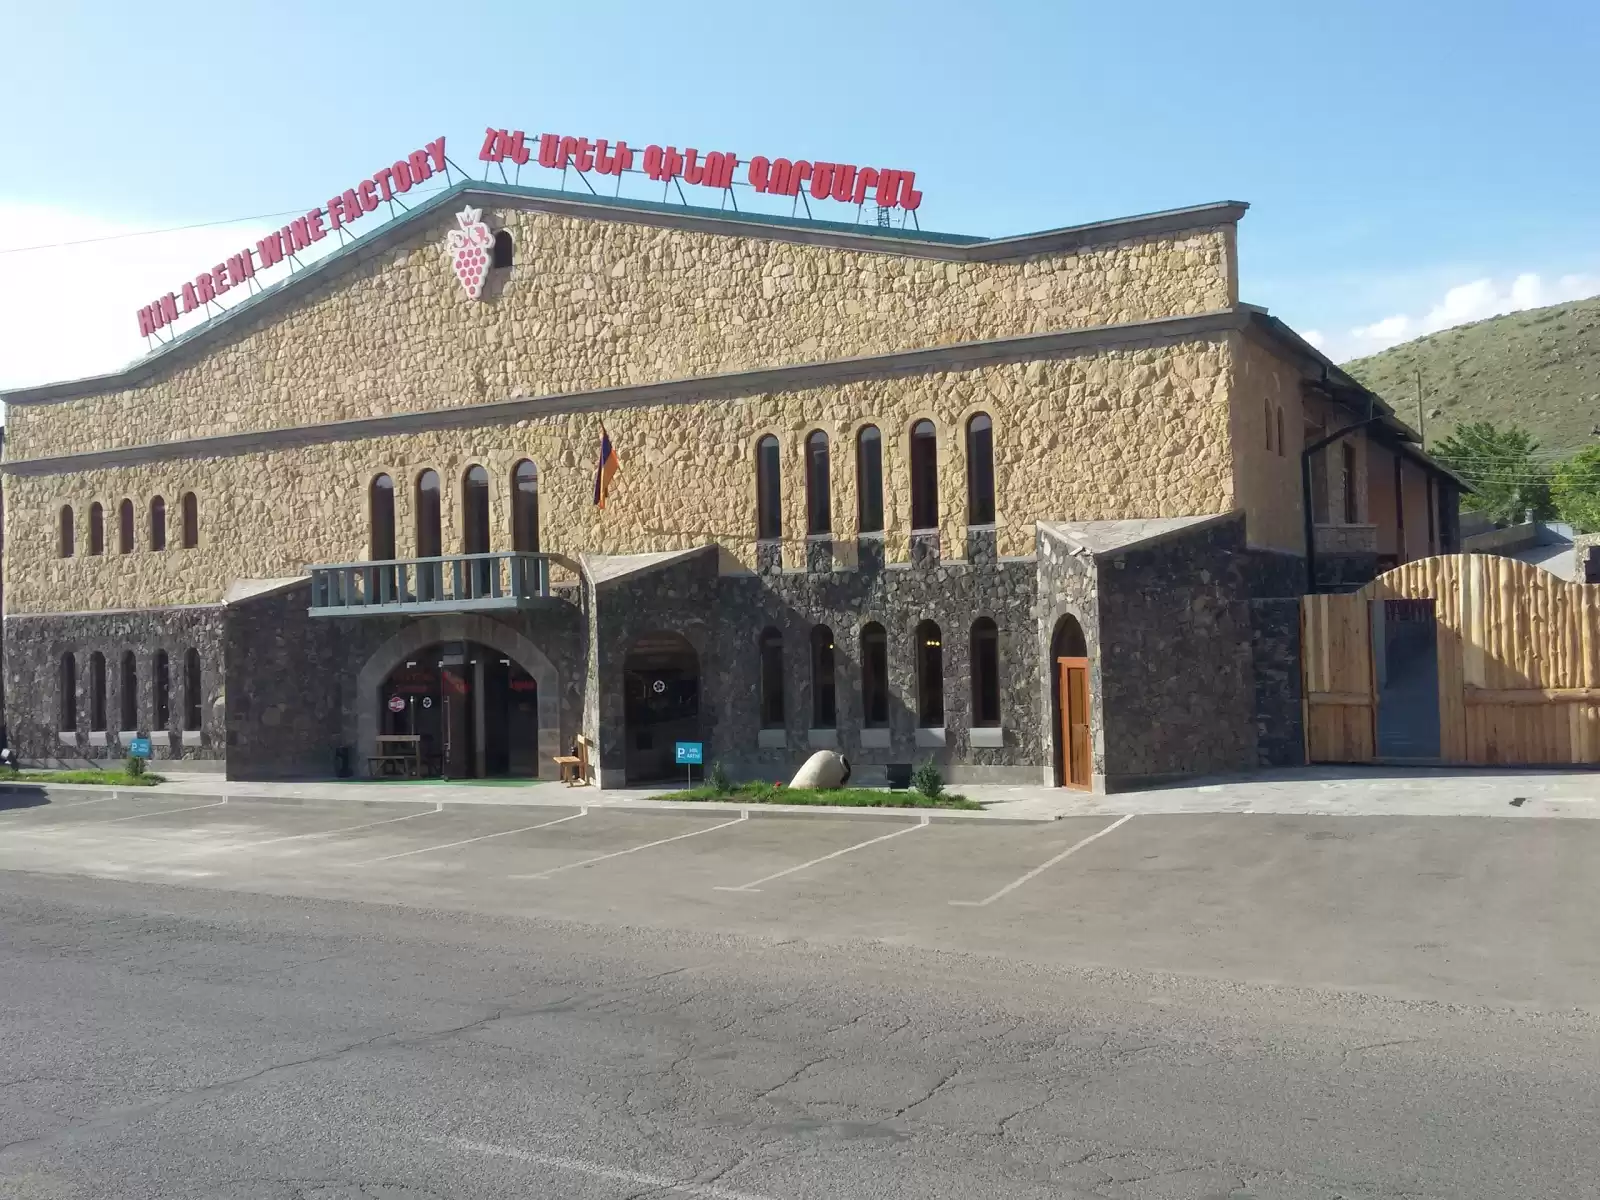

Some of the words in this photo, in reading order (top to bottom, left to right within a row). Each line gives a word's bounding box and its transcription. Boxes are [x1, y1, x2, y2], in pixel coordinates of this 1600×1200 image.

[479, 127, 531, 165] ՀԻՆ
[538, 133, 634, 176] ԱՐԵՆԻ
[748, 156, 923, 211] ԳՈՐԾԱՐԱՆ
[137, 292, 179, 337] HIN
[181, 248, 256, 313] ARENI
[256, 207, 327, 269] WINE
[327, 136, 447, 229] FACTORY
[677, 747, 686, 759] P
